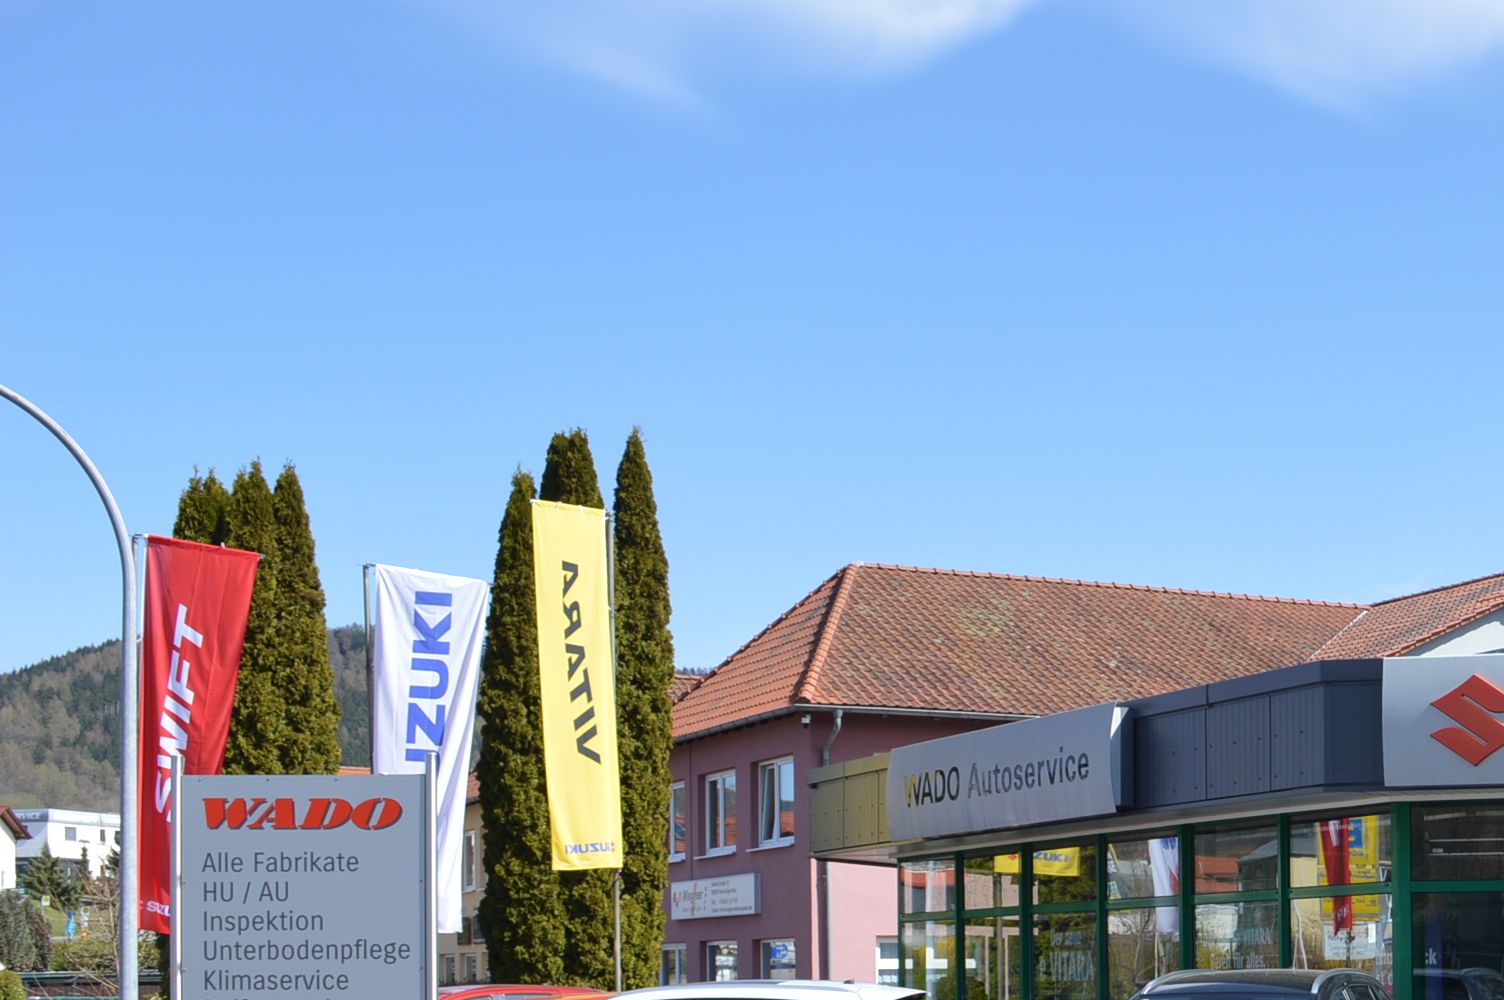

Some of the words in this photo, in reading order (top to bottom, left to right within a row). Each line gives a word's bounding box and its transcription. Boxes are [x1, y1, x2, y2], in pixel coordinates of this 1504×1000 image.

[404, 590, 453, 763] ZUKI
[904, 766, 960, 808] WADO
[967, 746, 1090, 799] Autoservice
[201, 797, 404, 831] WADO
[202, 852, 244, 873] Alle
[253, 851, 360, 873] Fabrikate
[203, 881, 234, 902] HU
[243, 881, 251, 904] /
[258, 881, 289, 902] AU
[203, 910, 324, 935] Inspektion
[203, 939, 411, 965] Unterbodenpflege
[203, 969, 350, 991] Klimaservice
